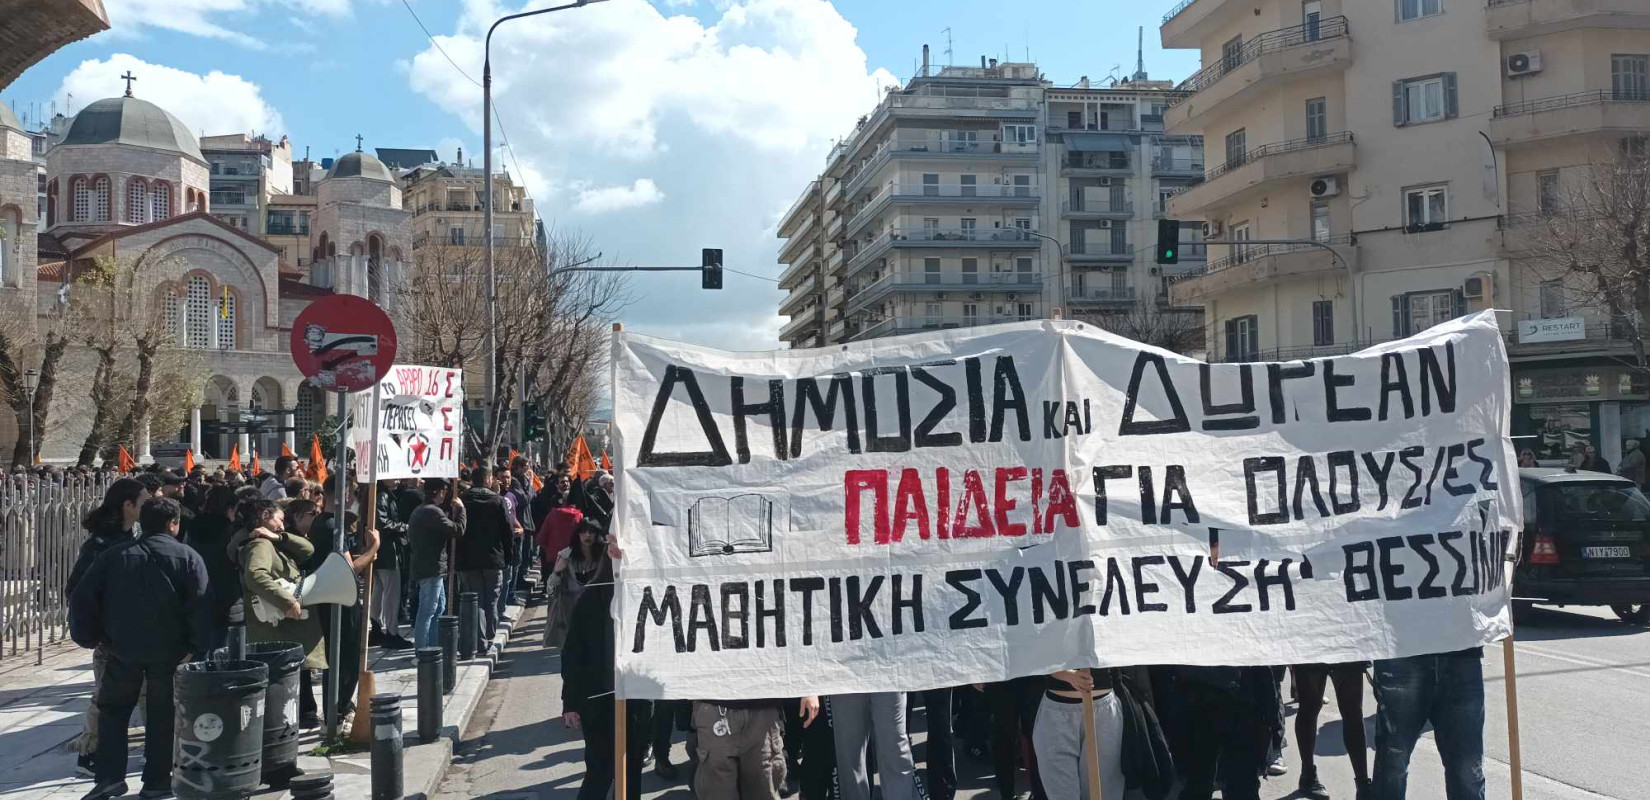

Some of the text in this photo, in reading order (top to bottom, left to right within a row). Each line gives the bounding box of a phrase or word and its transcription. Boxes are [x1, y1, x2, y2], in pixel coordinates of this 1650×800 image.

[1542, 322, 1580, 331] RESTART
[381, 382, 396, 395] ΤΟ
[425, 369, 440, 396] 16
[637, 356, 1032, 467] ΔΗΜΟΣΙΑ
[1043, 398, 1091, 439] ΚΑΙ
[844, 466, 1080, 545] ΠΑΙΔΕΙΑ
[1093, 465, 1200, 525] ΓΙΑ
[632, 574, 925, 653] ΜΑΘΗΤΙΚΗ
